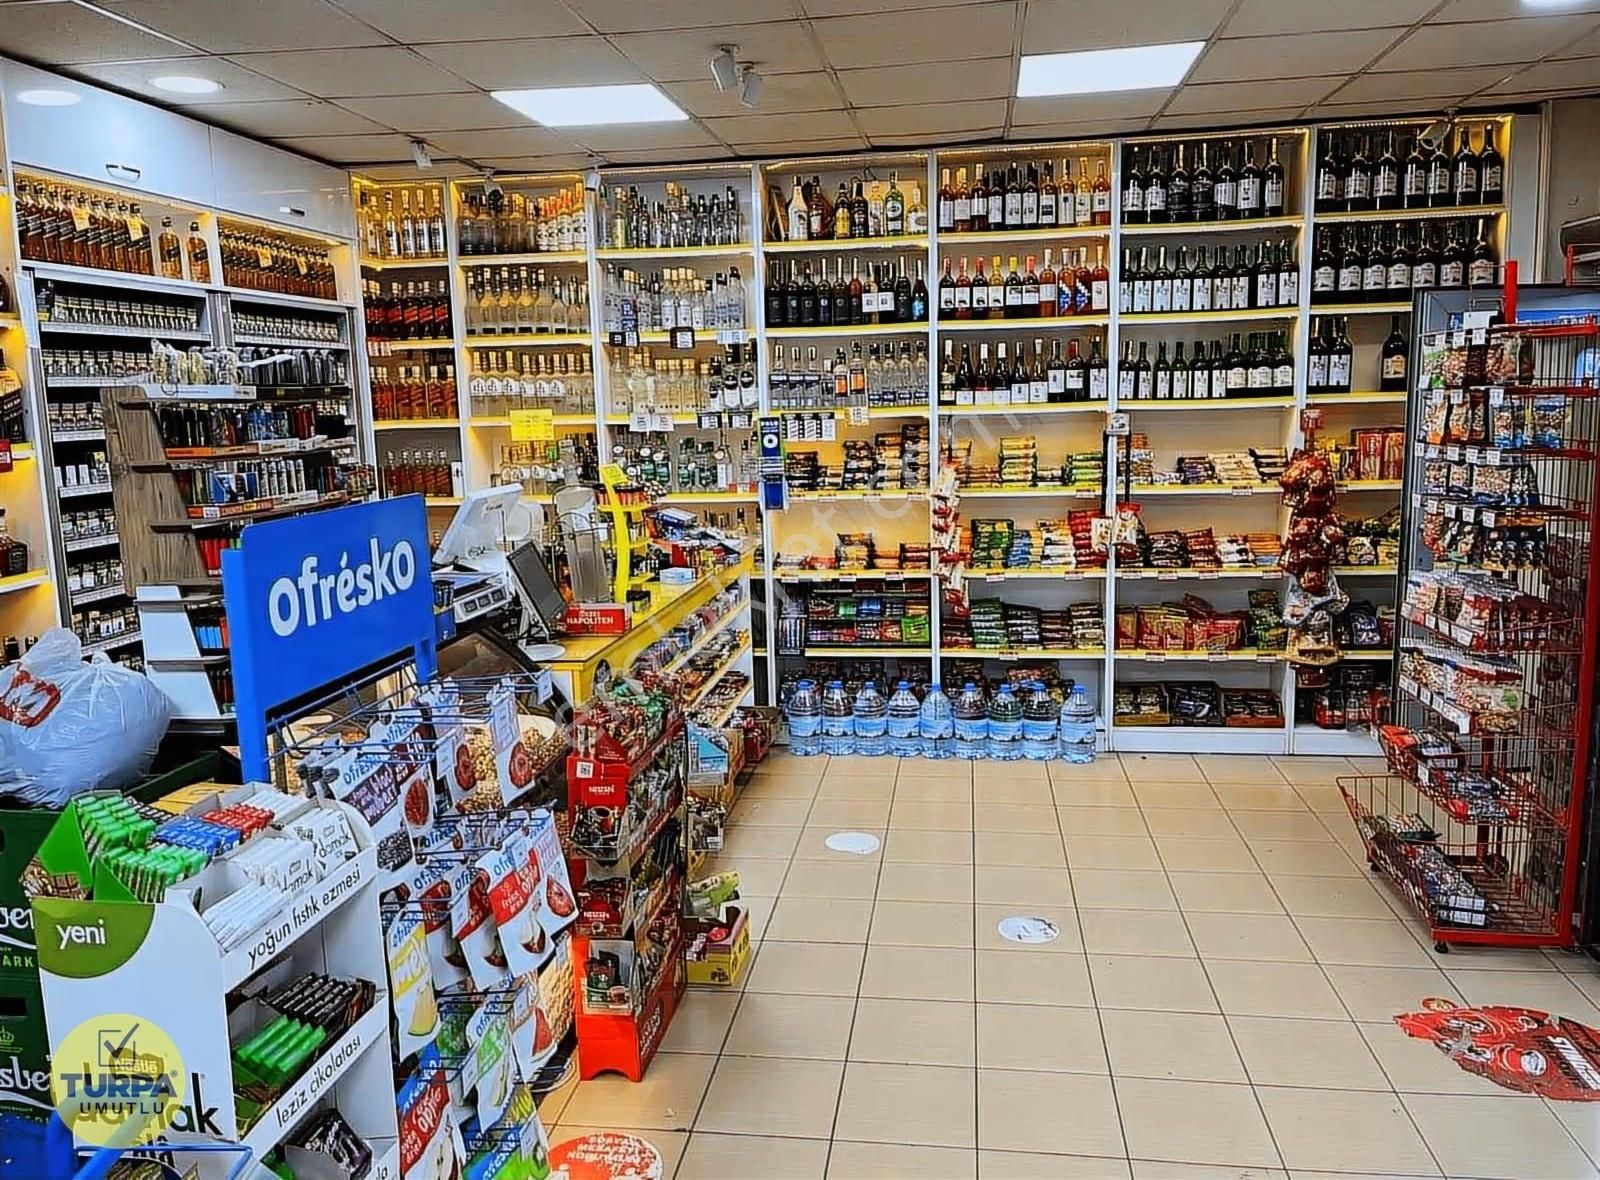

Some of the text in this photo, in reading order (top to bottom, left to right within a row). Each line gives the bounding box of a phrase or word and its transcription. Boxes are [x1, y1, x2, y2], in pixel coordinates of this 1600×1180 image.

[56, 919, 105, 949] yeni
[248, 864, 360, 970] yoğun fıstık ezmesi
[276, 1036, 361, 1127] leziz çikolatası
